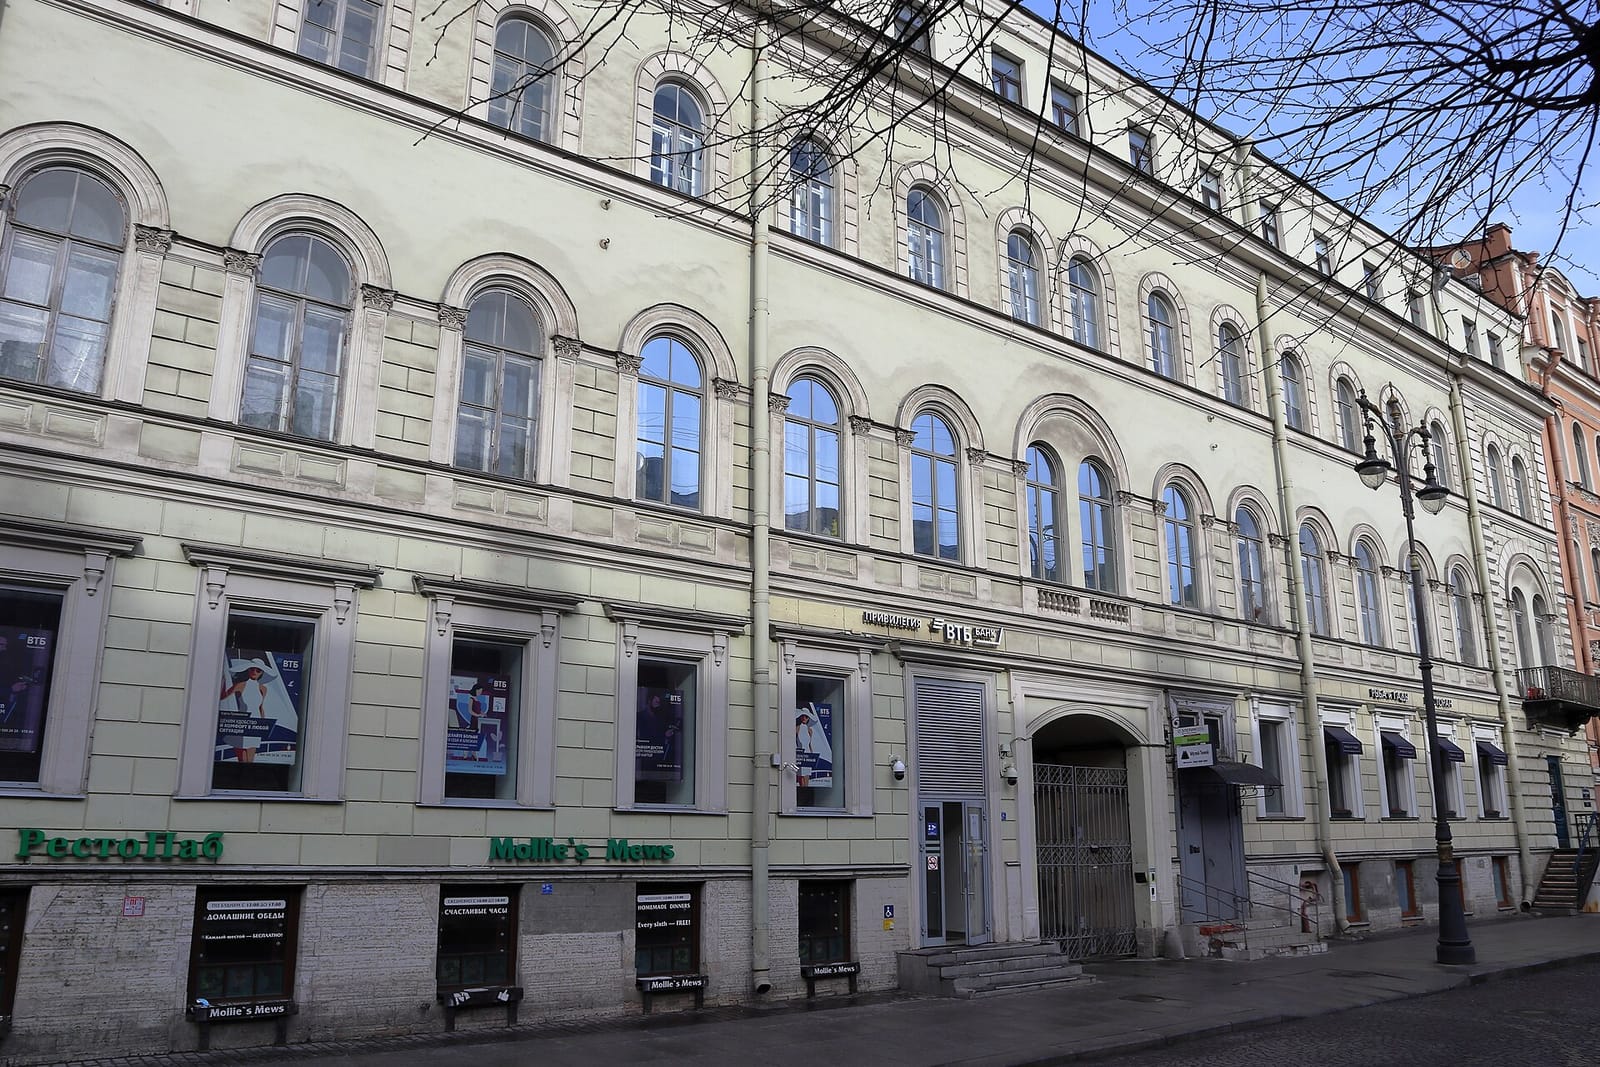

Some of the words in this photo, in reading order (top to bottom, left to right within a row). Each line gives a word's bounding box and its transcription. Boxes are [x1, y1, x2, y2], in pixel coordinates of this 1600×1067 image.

[864, 611, 921, 629] ПРИВИЛЕГИЯ
[945, 623, 972, 642] ВТБ
[974, 627, 997, 640] БАНК
[27, 636, 46, 645] ВТБ
[283, 660, 299, 669] ВТБ
[493, 680, 507, 688] ВТБ
[670, 694, 682, 702] ВТБ
[16, 829, 224, 858] РестоПаб
[605, 838, 675, 861] Mews
[838, 965, 855, 973] Mews
[681, 979, 702, 987] Mews
[254, 1005, 285, 1015] Mews
